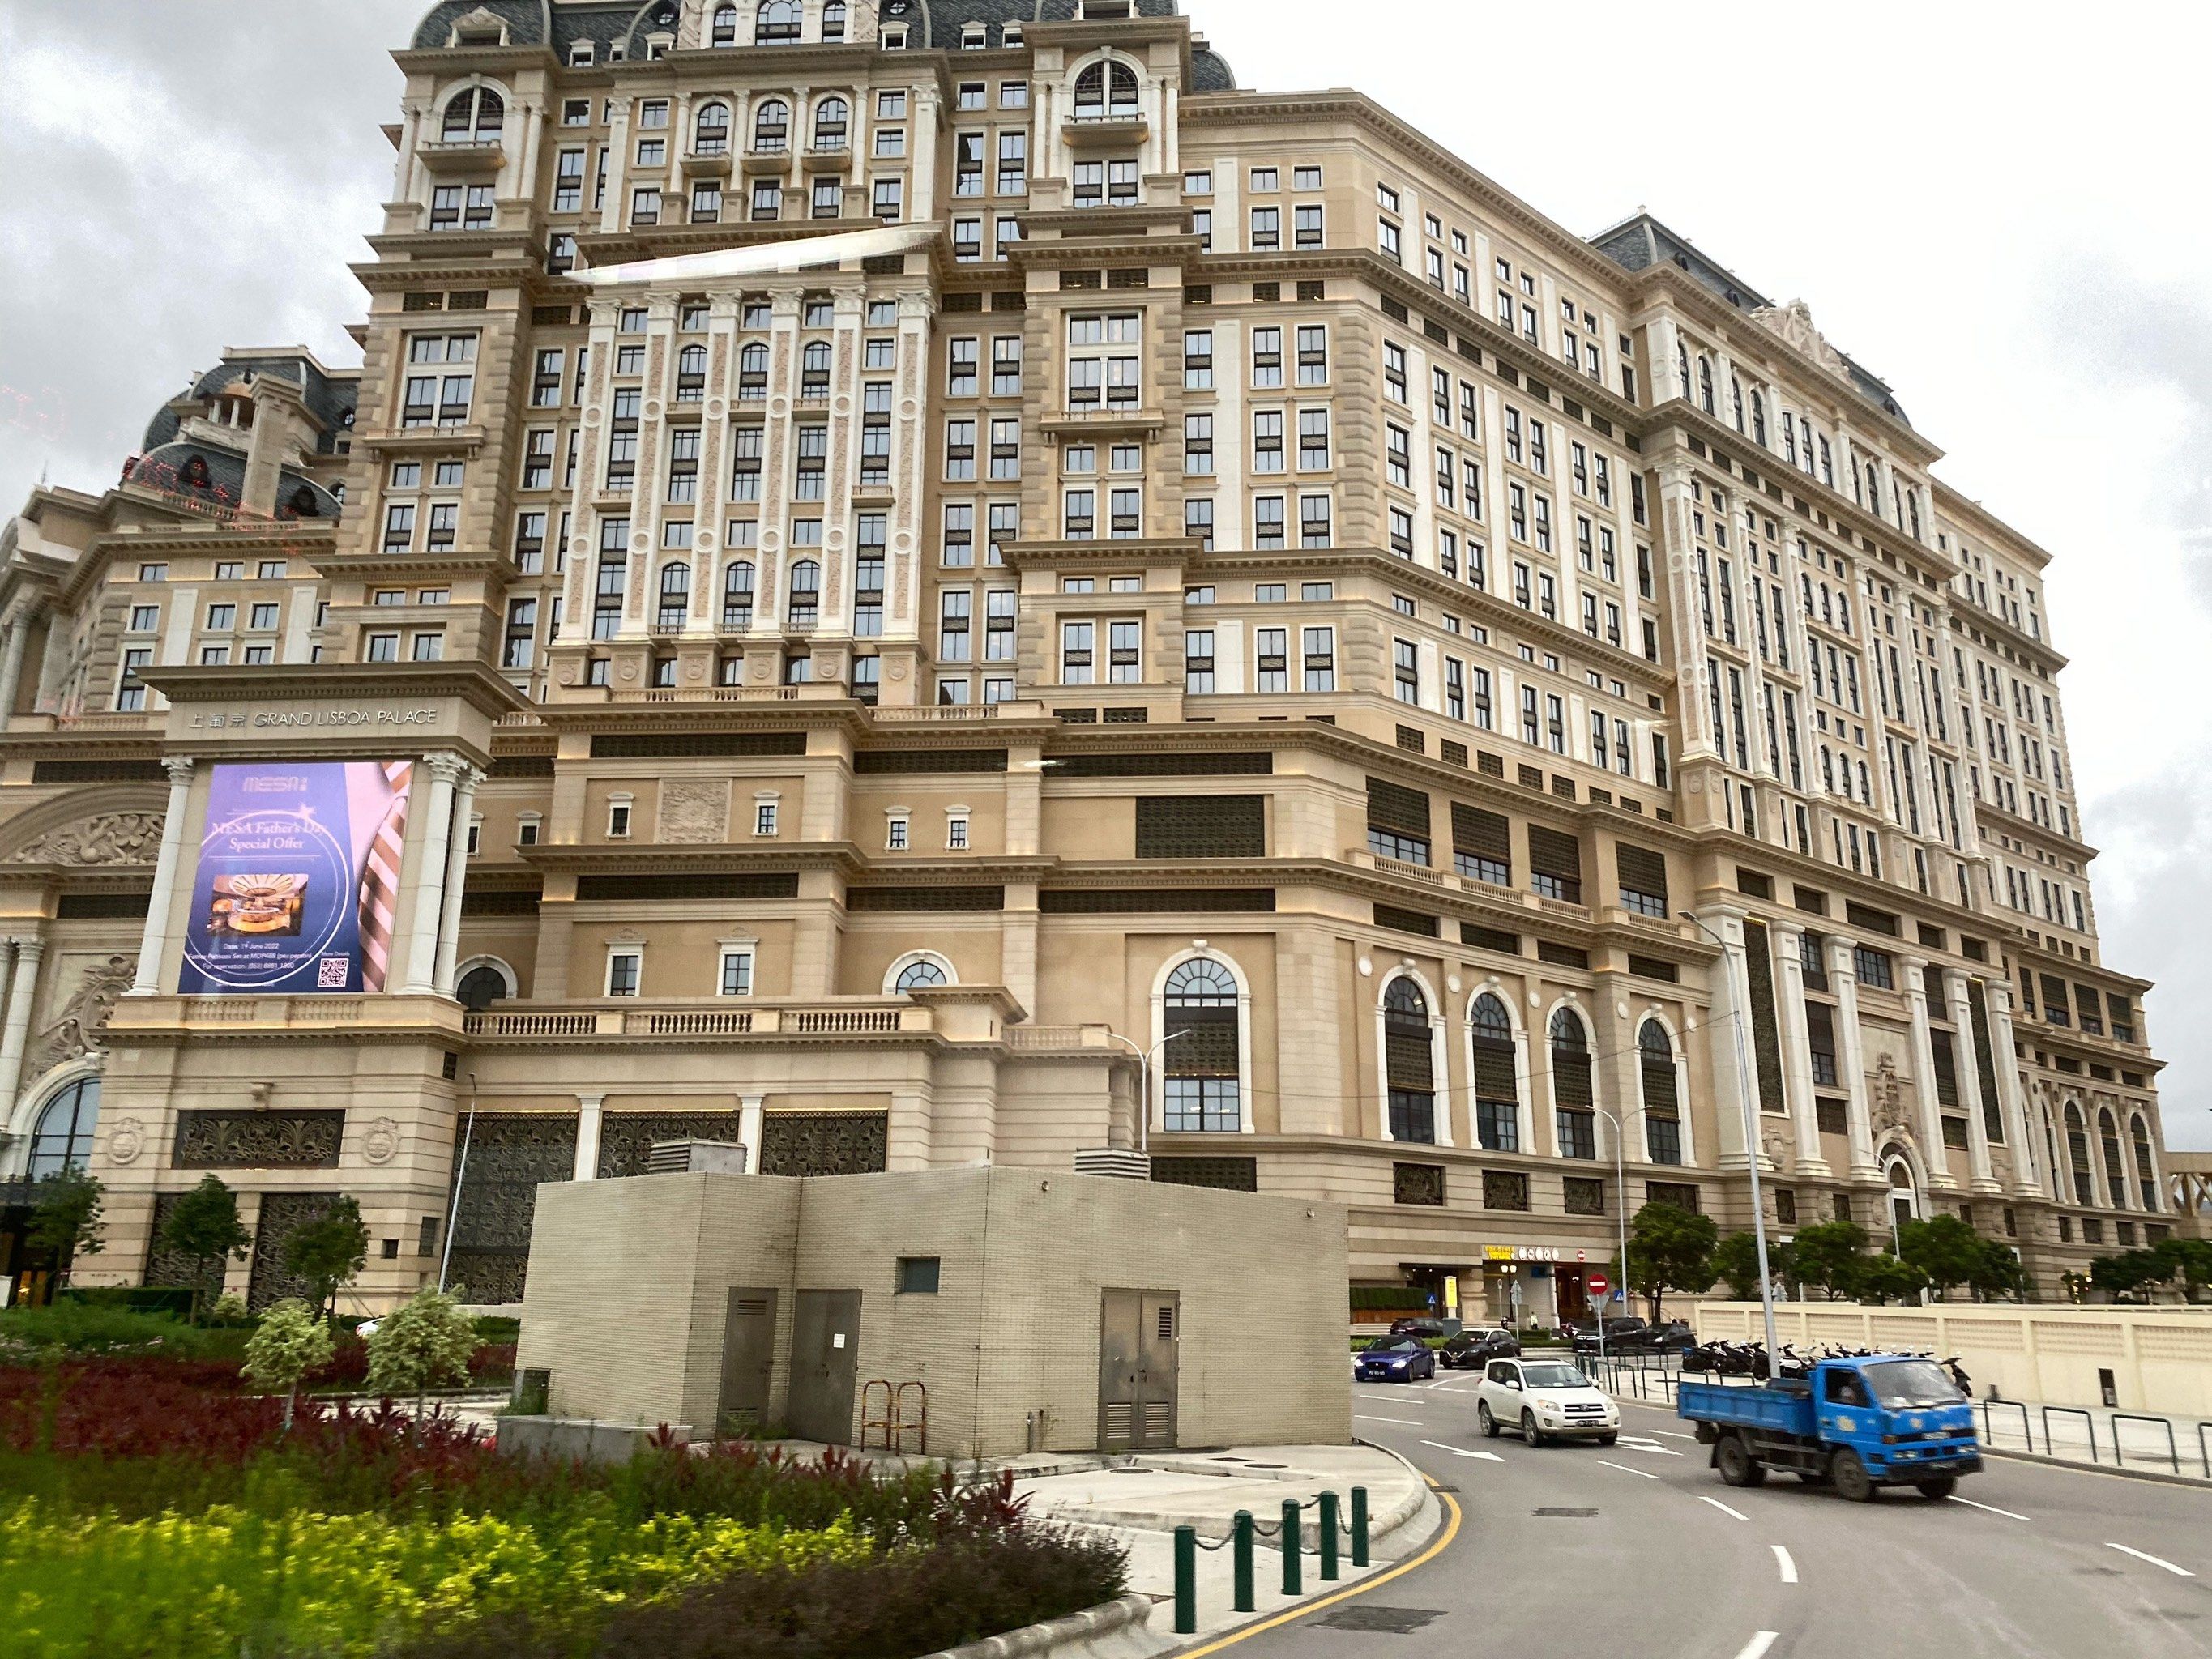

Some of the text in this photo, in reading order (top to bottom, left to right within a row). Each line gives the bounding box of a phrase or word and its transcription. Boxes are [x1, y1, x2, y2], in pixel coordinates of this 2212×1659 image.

[254, 710, 437, 727] GRAND LISBOA PALACE
[212, 822, 251, 834] MESA
[256, 821, 300, 834] Father's
[229, 837, 305, 853] Special Offer
